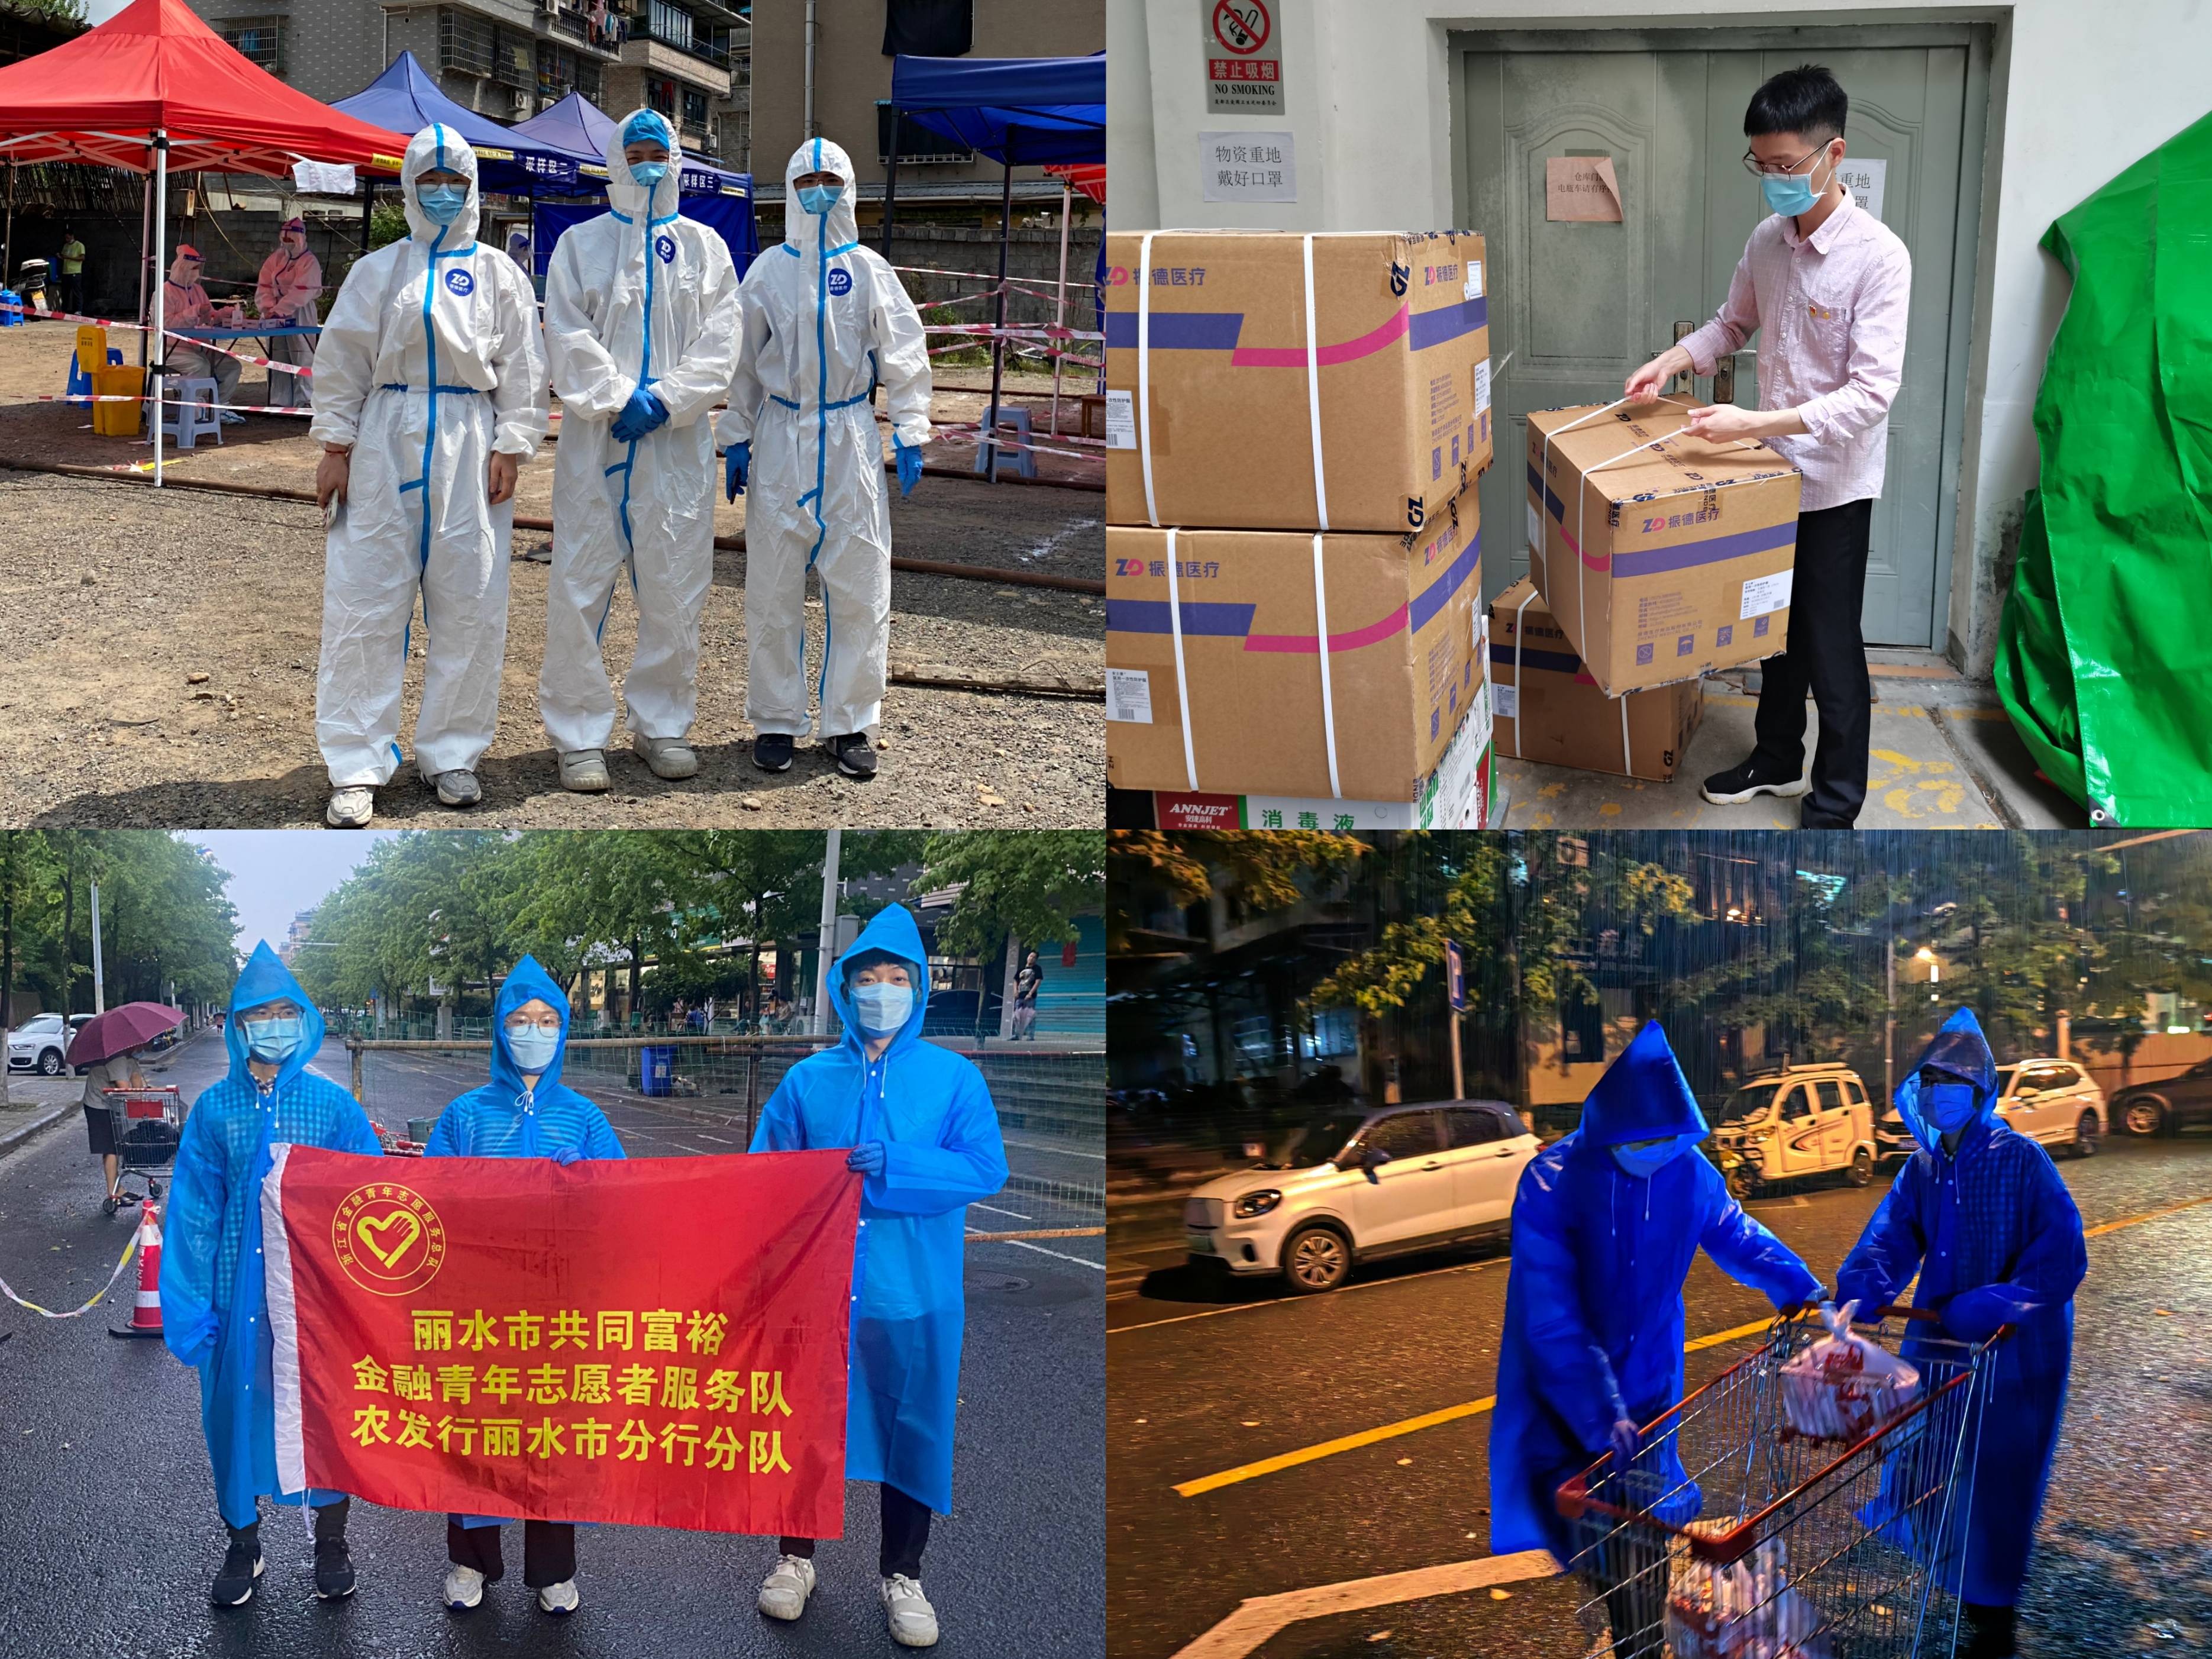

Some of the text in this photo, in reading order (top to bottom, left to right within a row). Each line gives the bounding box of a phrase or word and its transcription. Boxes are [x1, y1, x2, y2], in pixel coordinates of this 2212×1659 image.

[1213, 61, 1274, 79] 禁止吸烟
[1215, 84, 1275, 95] NO SMOKING
[1216, 146, 1282, 163] 物资重地
[1217, 170, 1283, 188] 戴好口罩
[1575, 172, 1603, 182] 仓库门
[451, 273, 470, 286] ZD
[830, 274, 847, 285] ZD
[1436, 264, 1458, 283] 振德医疗
[1642, 509, 1720, 533] ZD 振德医疗
[1115, 559, 1144, 576] ZD
[1170, 803, 1229, 816] ANNJET
[1261, 809, 1355, 830] 消毒液
[411, 1308, 729, 1356] 丽水市共同富裕
[351, 1354, 793, 1417] 金融青年志愿者服务队
[350, 1404, 793, 1475] 农发行丽水市分行分队
